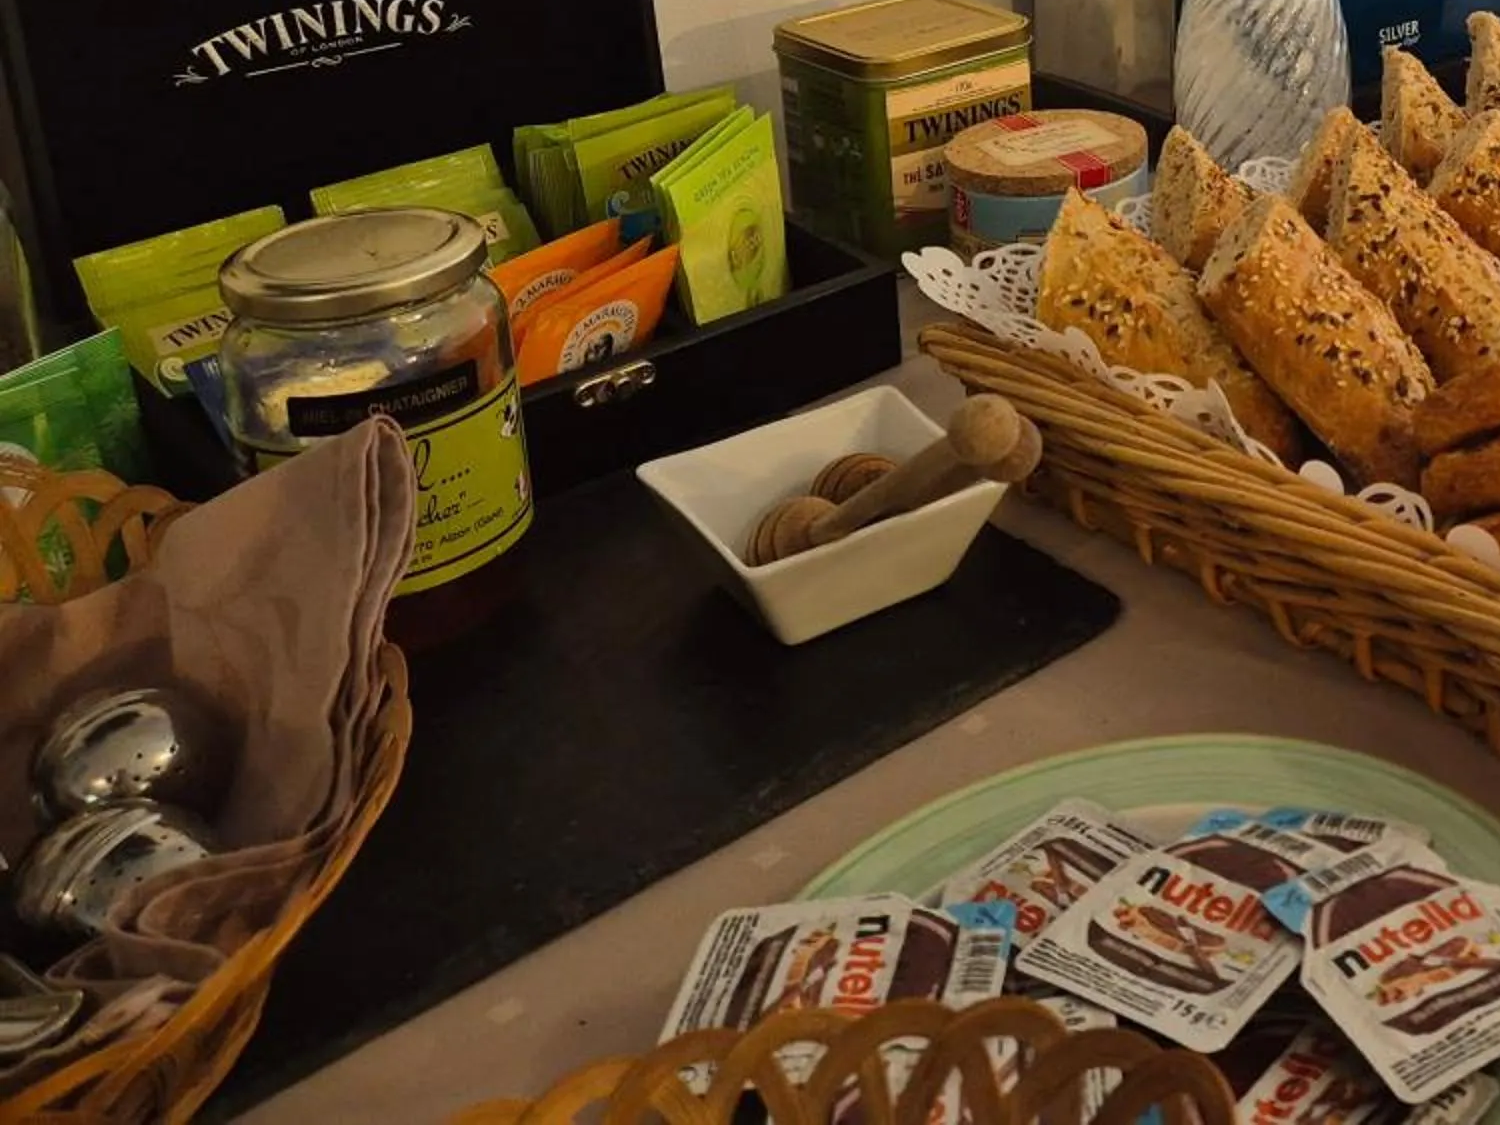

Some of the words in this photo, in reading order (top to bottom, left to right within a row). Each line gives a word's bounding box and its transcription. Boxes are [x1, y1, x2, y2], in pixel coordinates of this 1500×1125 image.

[289, 47, 308, 58] OF
[311, 35, 364, 53] LONDON
[1379, 20, 1419, 45] SILVER
[903, 93, 1021, 145] TWININGS
[1137, 865, 1276, 942] nutella
[1331, 890, 1485, 980] nutella
[832, 913, 891, 1017] nutell
